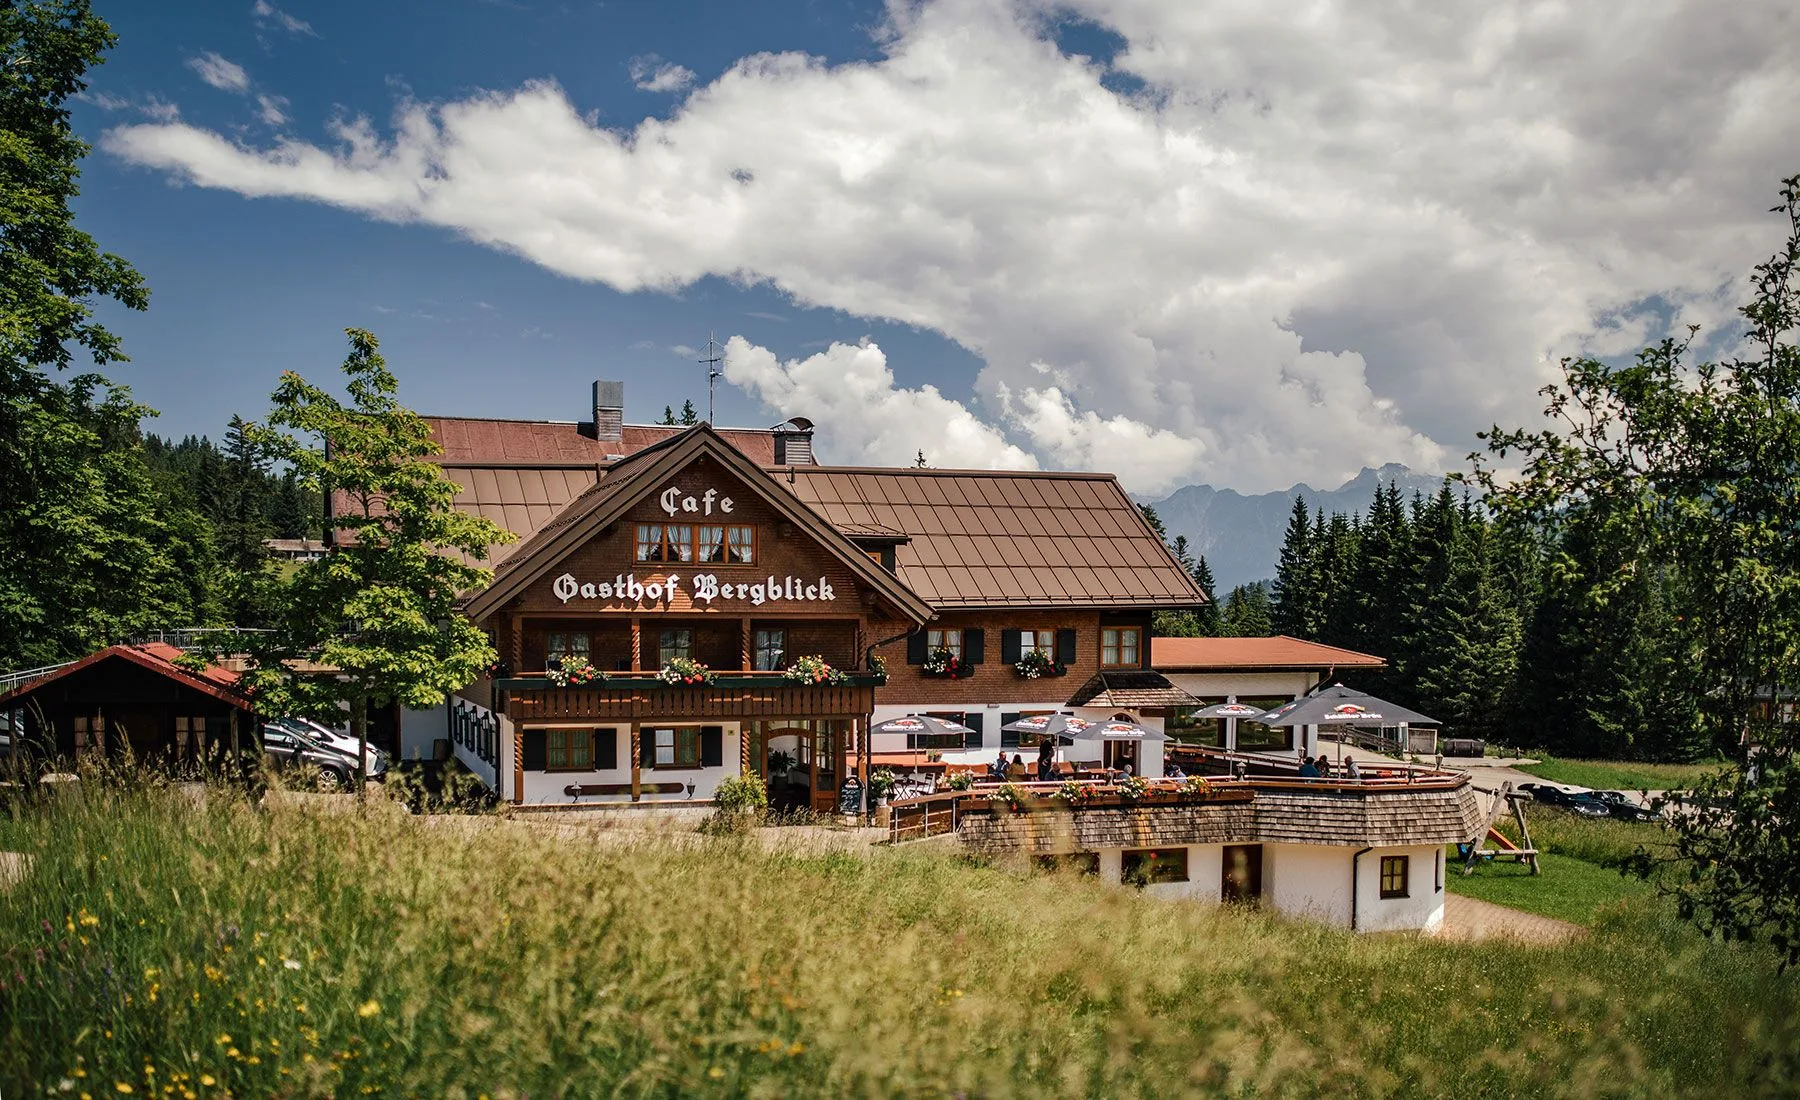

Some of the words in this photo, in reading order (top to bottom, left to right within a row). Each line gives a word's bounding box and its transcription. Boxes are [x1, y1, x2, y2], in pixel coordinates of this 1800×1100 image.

[660, 486, 734, 517] Cafe
[553, 573, 680, 603] Gasthof
[693, 573, 836, 606] Bergblick
